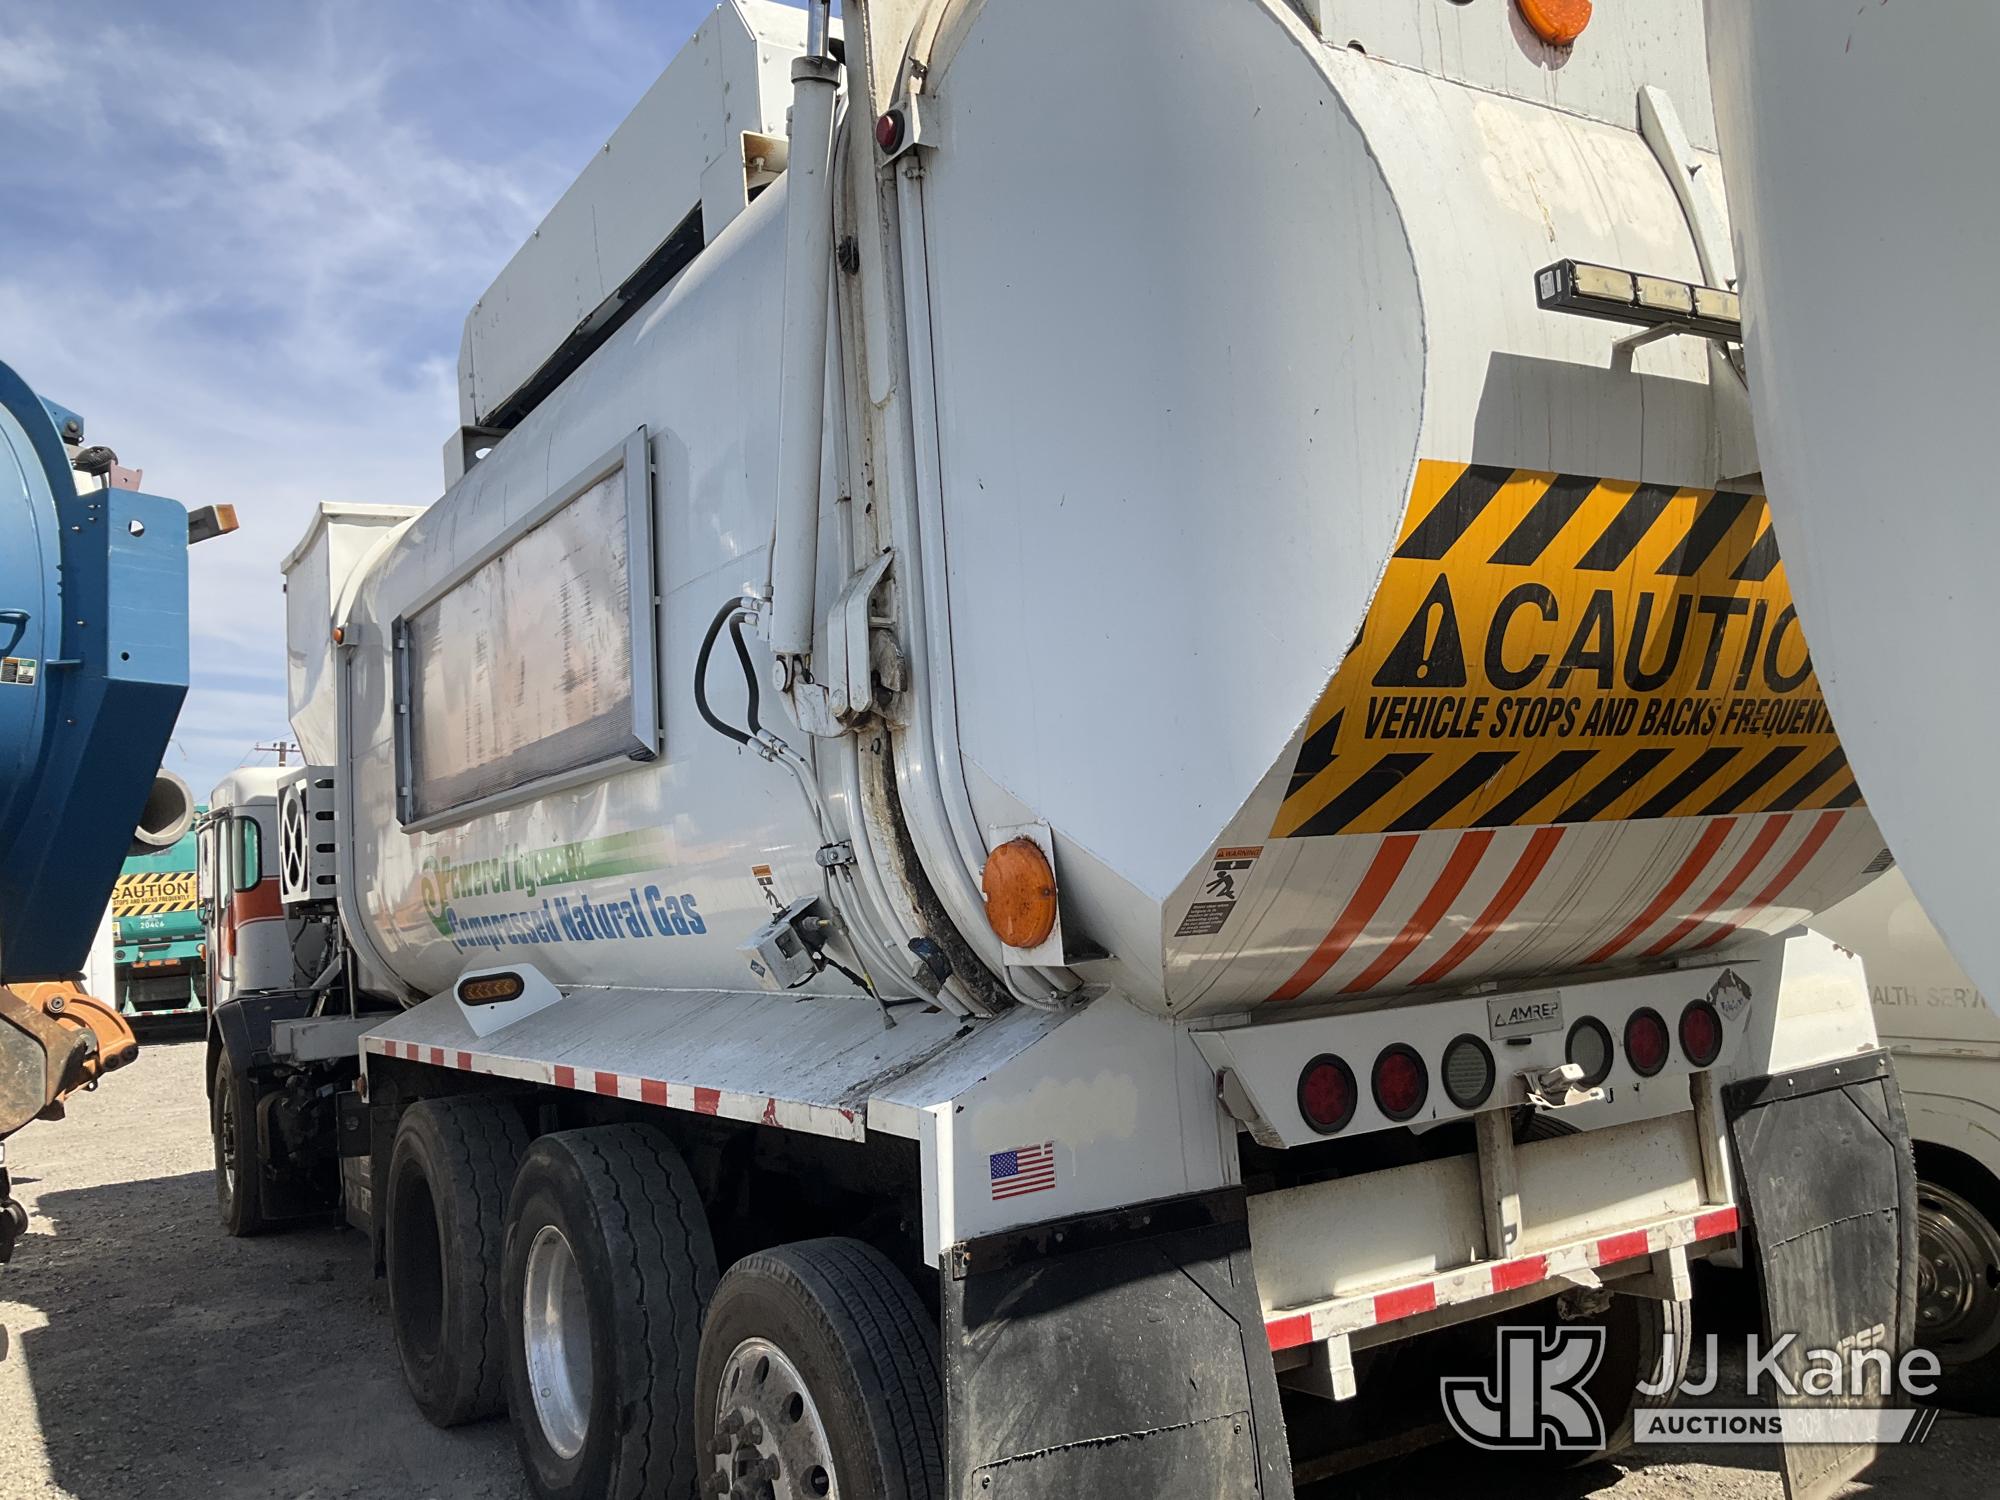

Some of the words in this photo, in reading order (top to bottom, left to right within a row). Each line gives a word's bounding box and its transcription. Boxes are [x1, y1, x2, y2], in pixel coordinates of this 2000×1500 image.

[1484, 583, 1821, 692] CAUTIO
[1364, 696, 1489, 739] VEHICLE
[1489, 696, 1581, 739] STOPS
[1580, 697, 1640, 737] AND
[1637, 697, 1721, 736] BACKS
[112, 882, 189, 900] CAUTION
[446, 898, 563, 955] Compressed
[554, 887, 654, 942] Natural
[644, 885, 707, 937] Gas
